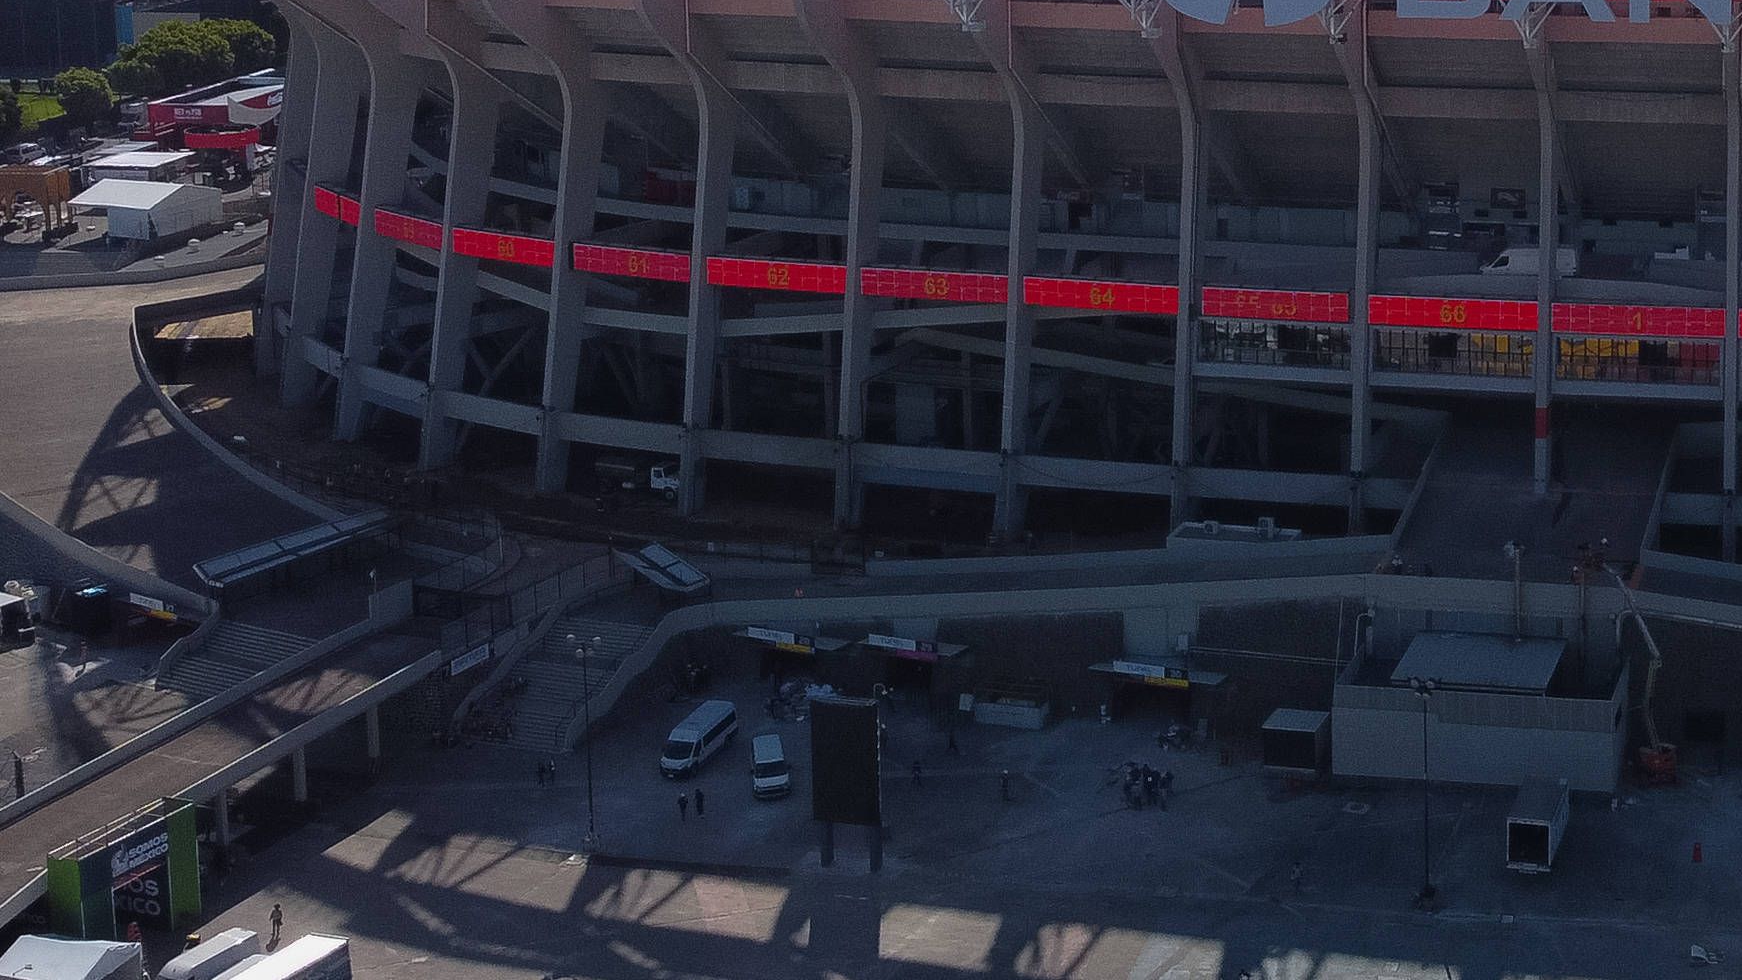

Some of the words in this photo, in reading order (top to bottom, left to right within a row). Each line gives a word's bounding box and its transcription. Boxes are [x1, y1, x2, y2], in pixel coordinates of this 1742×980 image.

[767, 266, 790, 288] 62
[925, 276, 950, 297] 63
[1090, 286, 1115, 308] 64
[1439, 304, 1466, 325] 66
[1632, 312, 1642, 331] 1
[128, 832, 169, 858] SOMOS
